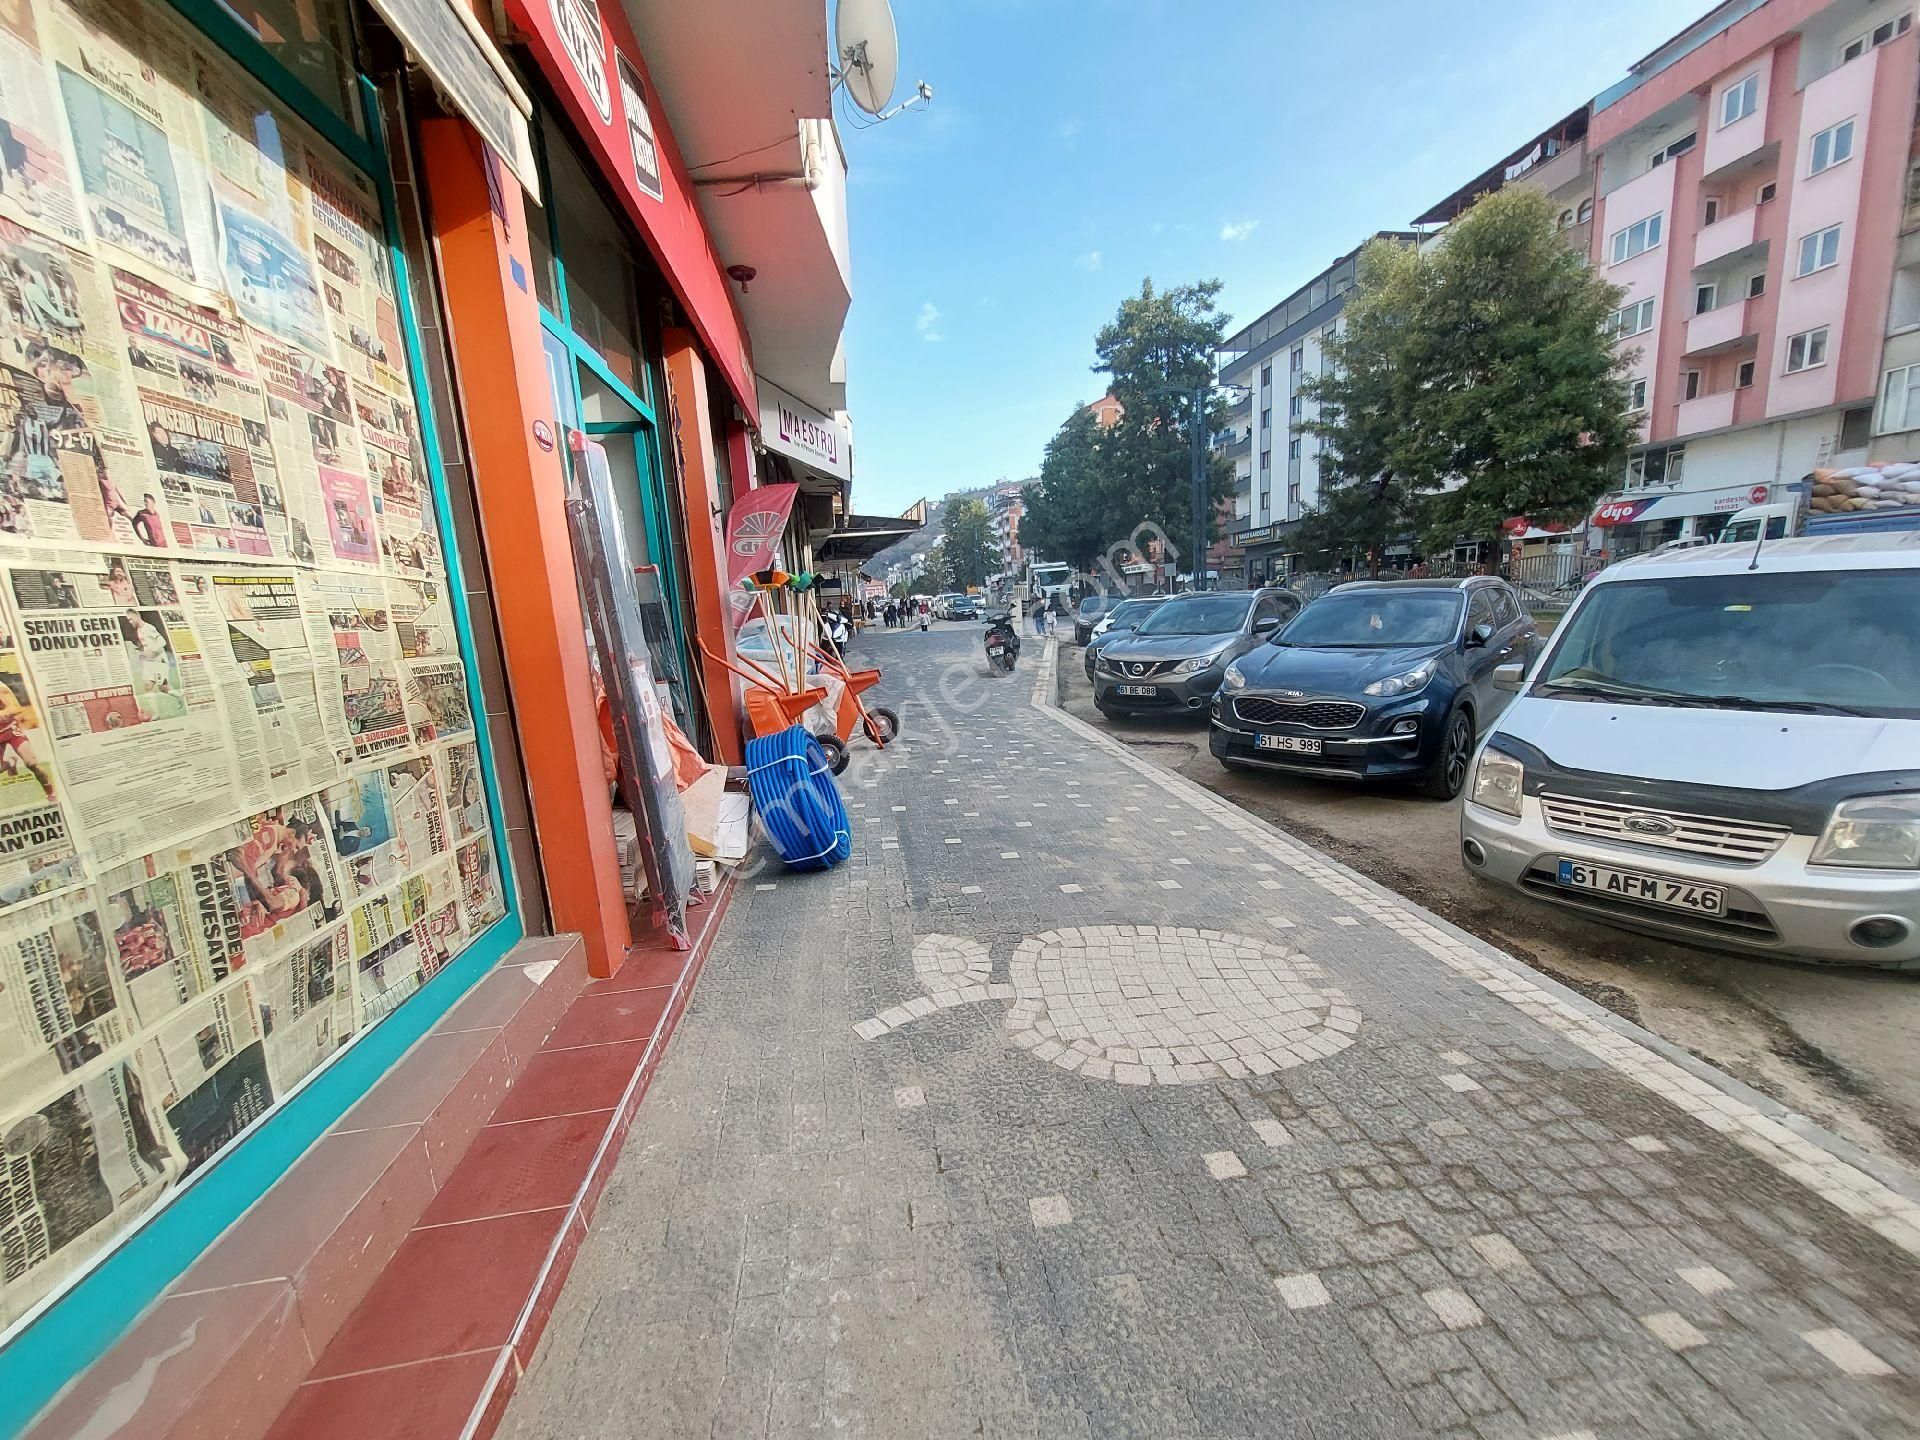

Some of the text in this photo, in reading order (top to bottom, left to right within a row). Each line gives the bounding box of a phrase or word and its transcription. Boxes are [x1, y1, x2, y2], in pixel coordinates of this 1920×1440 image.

[138, 304, 207, 349] TAKA
[360, 424, 410, 454] Cumartes
[783, 408, 834, 453] MAESTRO
[1600, 503, 1634, 527] dyo
[23, 617, 117, 636] SEMİH GERİ
[29, 632, 120, 652] DÖNÜYOR!
[1129, 686, 1139, 694] BE
[354, 743, 368, 756] VAR
[1260, 736, 1320, 751] 61 HS 989
[1636, 820, 1663, 832] Ford
[469, 847, 482, 890] SABAH
[1573, 867, 1718, 910] 61 AFM 746
[337, 927, 348, 961] SABAH
[414, 922, 424, 948] KURA
[420, 918, 435, 954] LOKUM
[28, 975, 59, 1044] TOLERANS
